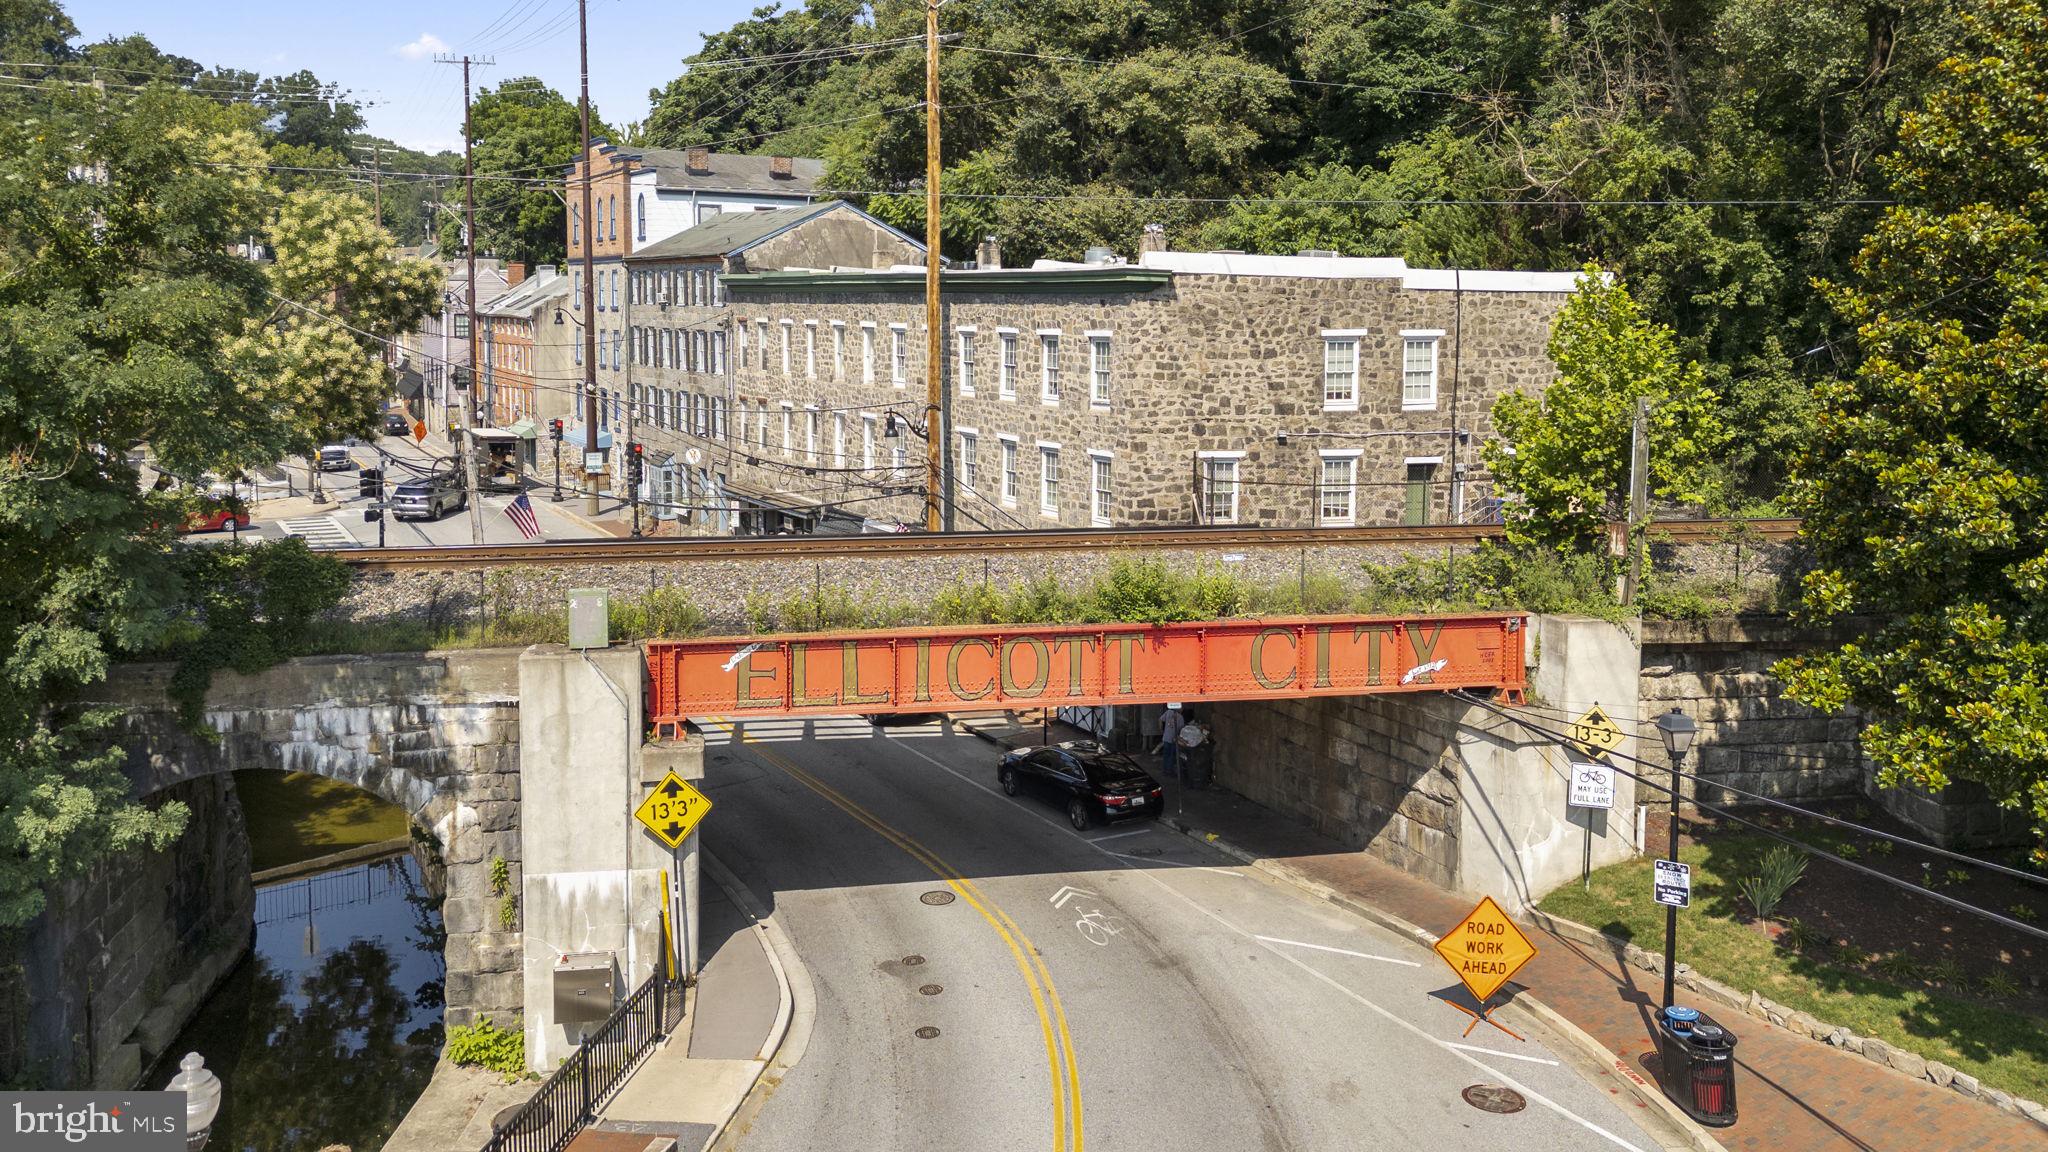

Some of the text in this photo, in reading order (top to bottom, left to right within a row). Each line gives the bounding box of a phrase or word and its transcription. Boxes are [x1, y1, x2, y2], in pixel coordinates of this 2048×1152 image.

[735, 622, 1445, 709] ELLICOTT CITY
[1577, 785, 1608, 795] MAY USE
[1573, 794, 1610, 805] FULL LANE
[1662, 870, 1682, 878] SNOW
[1467, 921, 1505, 936] ROAD
[1465, 941, 1504, 955] WORK
[1462, 960, 1507, 975] AHEAD
